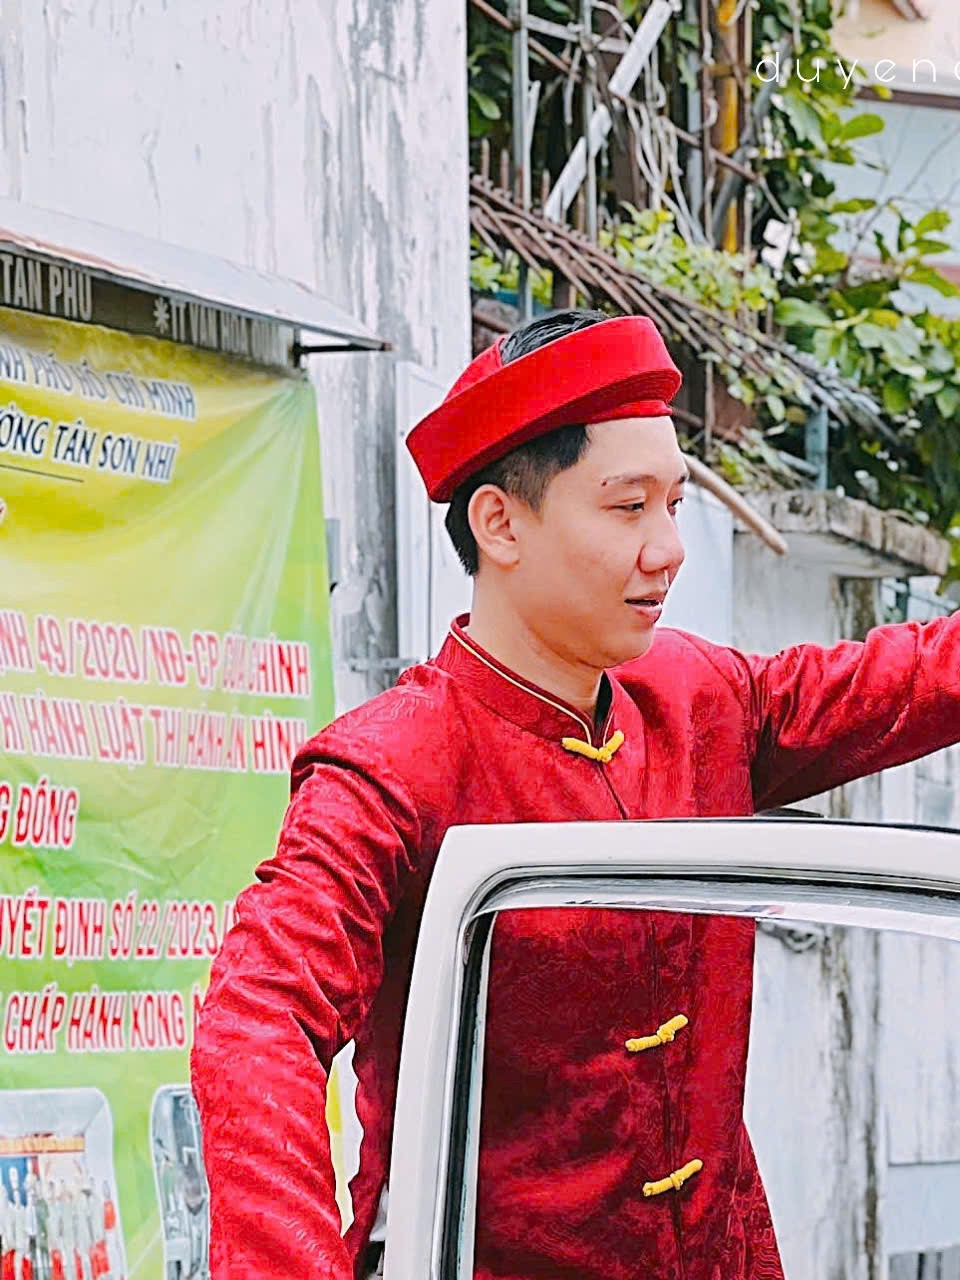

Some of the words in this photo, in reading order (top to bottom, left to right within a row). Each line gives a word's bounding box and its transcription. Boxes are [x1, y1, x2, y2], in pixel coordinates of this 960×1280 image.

[141, 379, 196, 420] MINH
[54, 419, 97, 466] TÂN
[98, 434, 142, 475] SƠN
[37, 616, 218, 686] 49/2020/NĐ-CP
[149, 708, 182, 766] THI
[54, 898, 104, 966] ĐỊNH
[5, 982, 66, 1051] CHẤP
[67, 984, 126, 1050] HÀNH
[130, 993, 187, 1047] XONG
